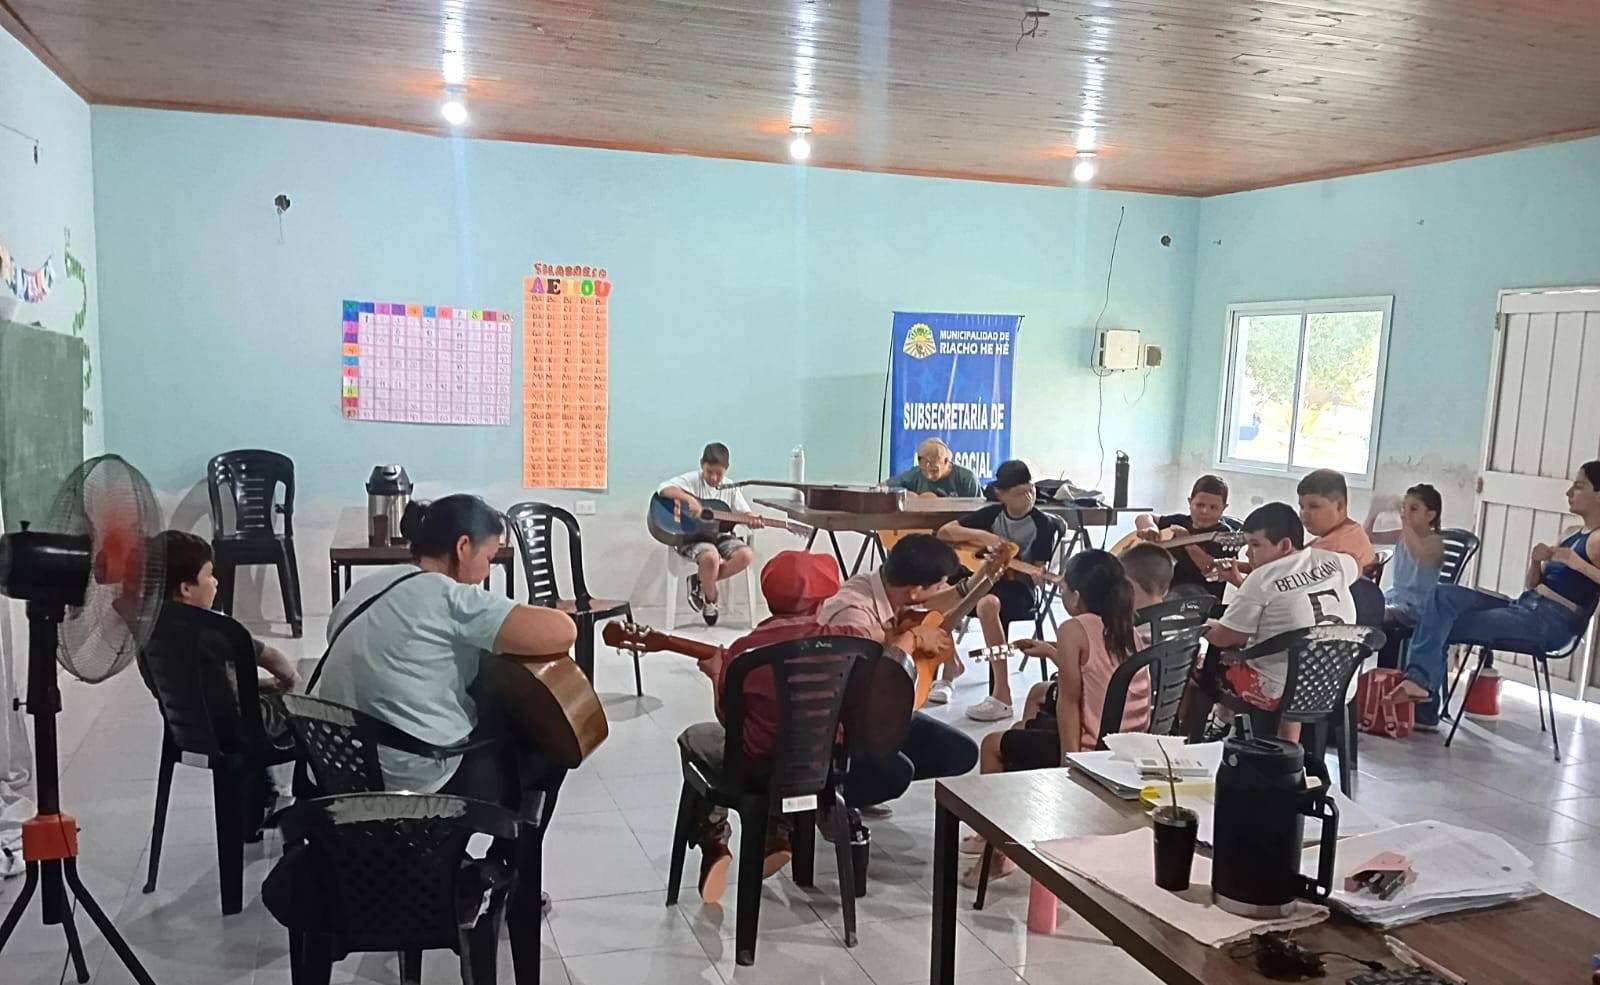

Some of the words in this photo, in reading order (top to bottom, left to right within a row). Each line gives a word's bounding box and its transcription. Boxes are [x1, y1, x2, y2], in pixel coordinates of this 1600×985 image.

[940, 330, 998, 341] MUNICIPALIDAD
[1000, 331, 1010, 341] DE
[940, 342, 978, 354] RIACHO
[980, 343, 993, 355] HE
[903, 396, 988, 430] SUBSECRETARÍA
[991, 402, 1005, 430] DE
